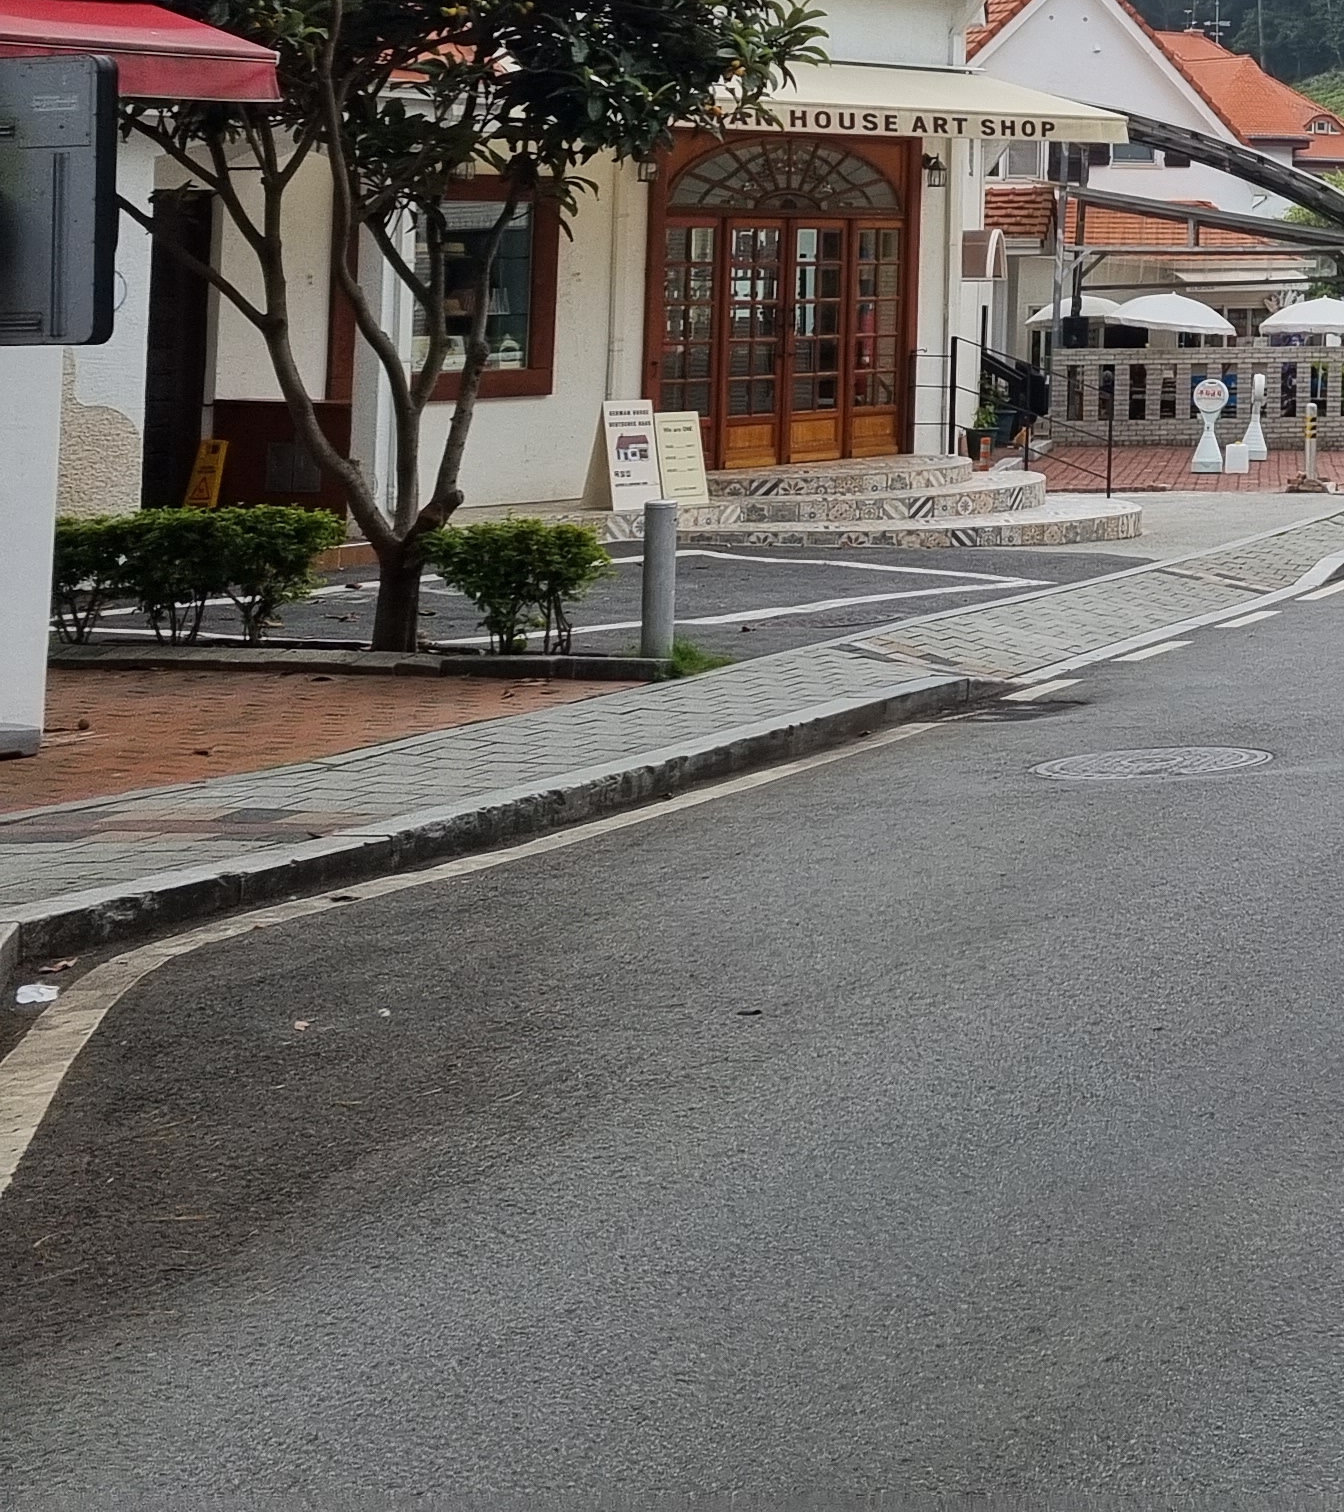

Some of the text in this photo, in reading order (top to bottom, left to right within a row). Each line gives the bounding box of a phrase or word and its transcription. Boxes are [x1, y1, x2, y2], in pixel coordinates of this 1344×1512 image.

[790, 109, 899, 133] HOUSE
[911, 115, 969, 135] ART
[980, 119, 1057, 137] SHOP
